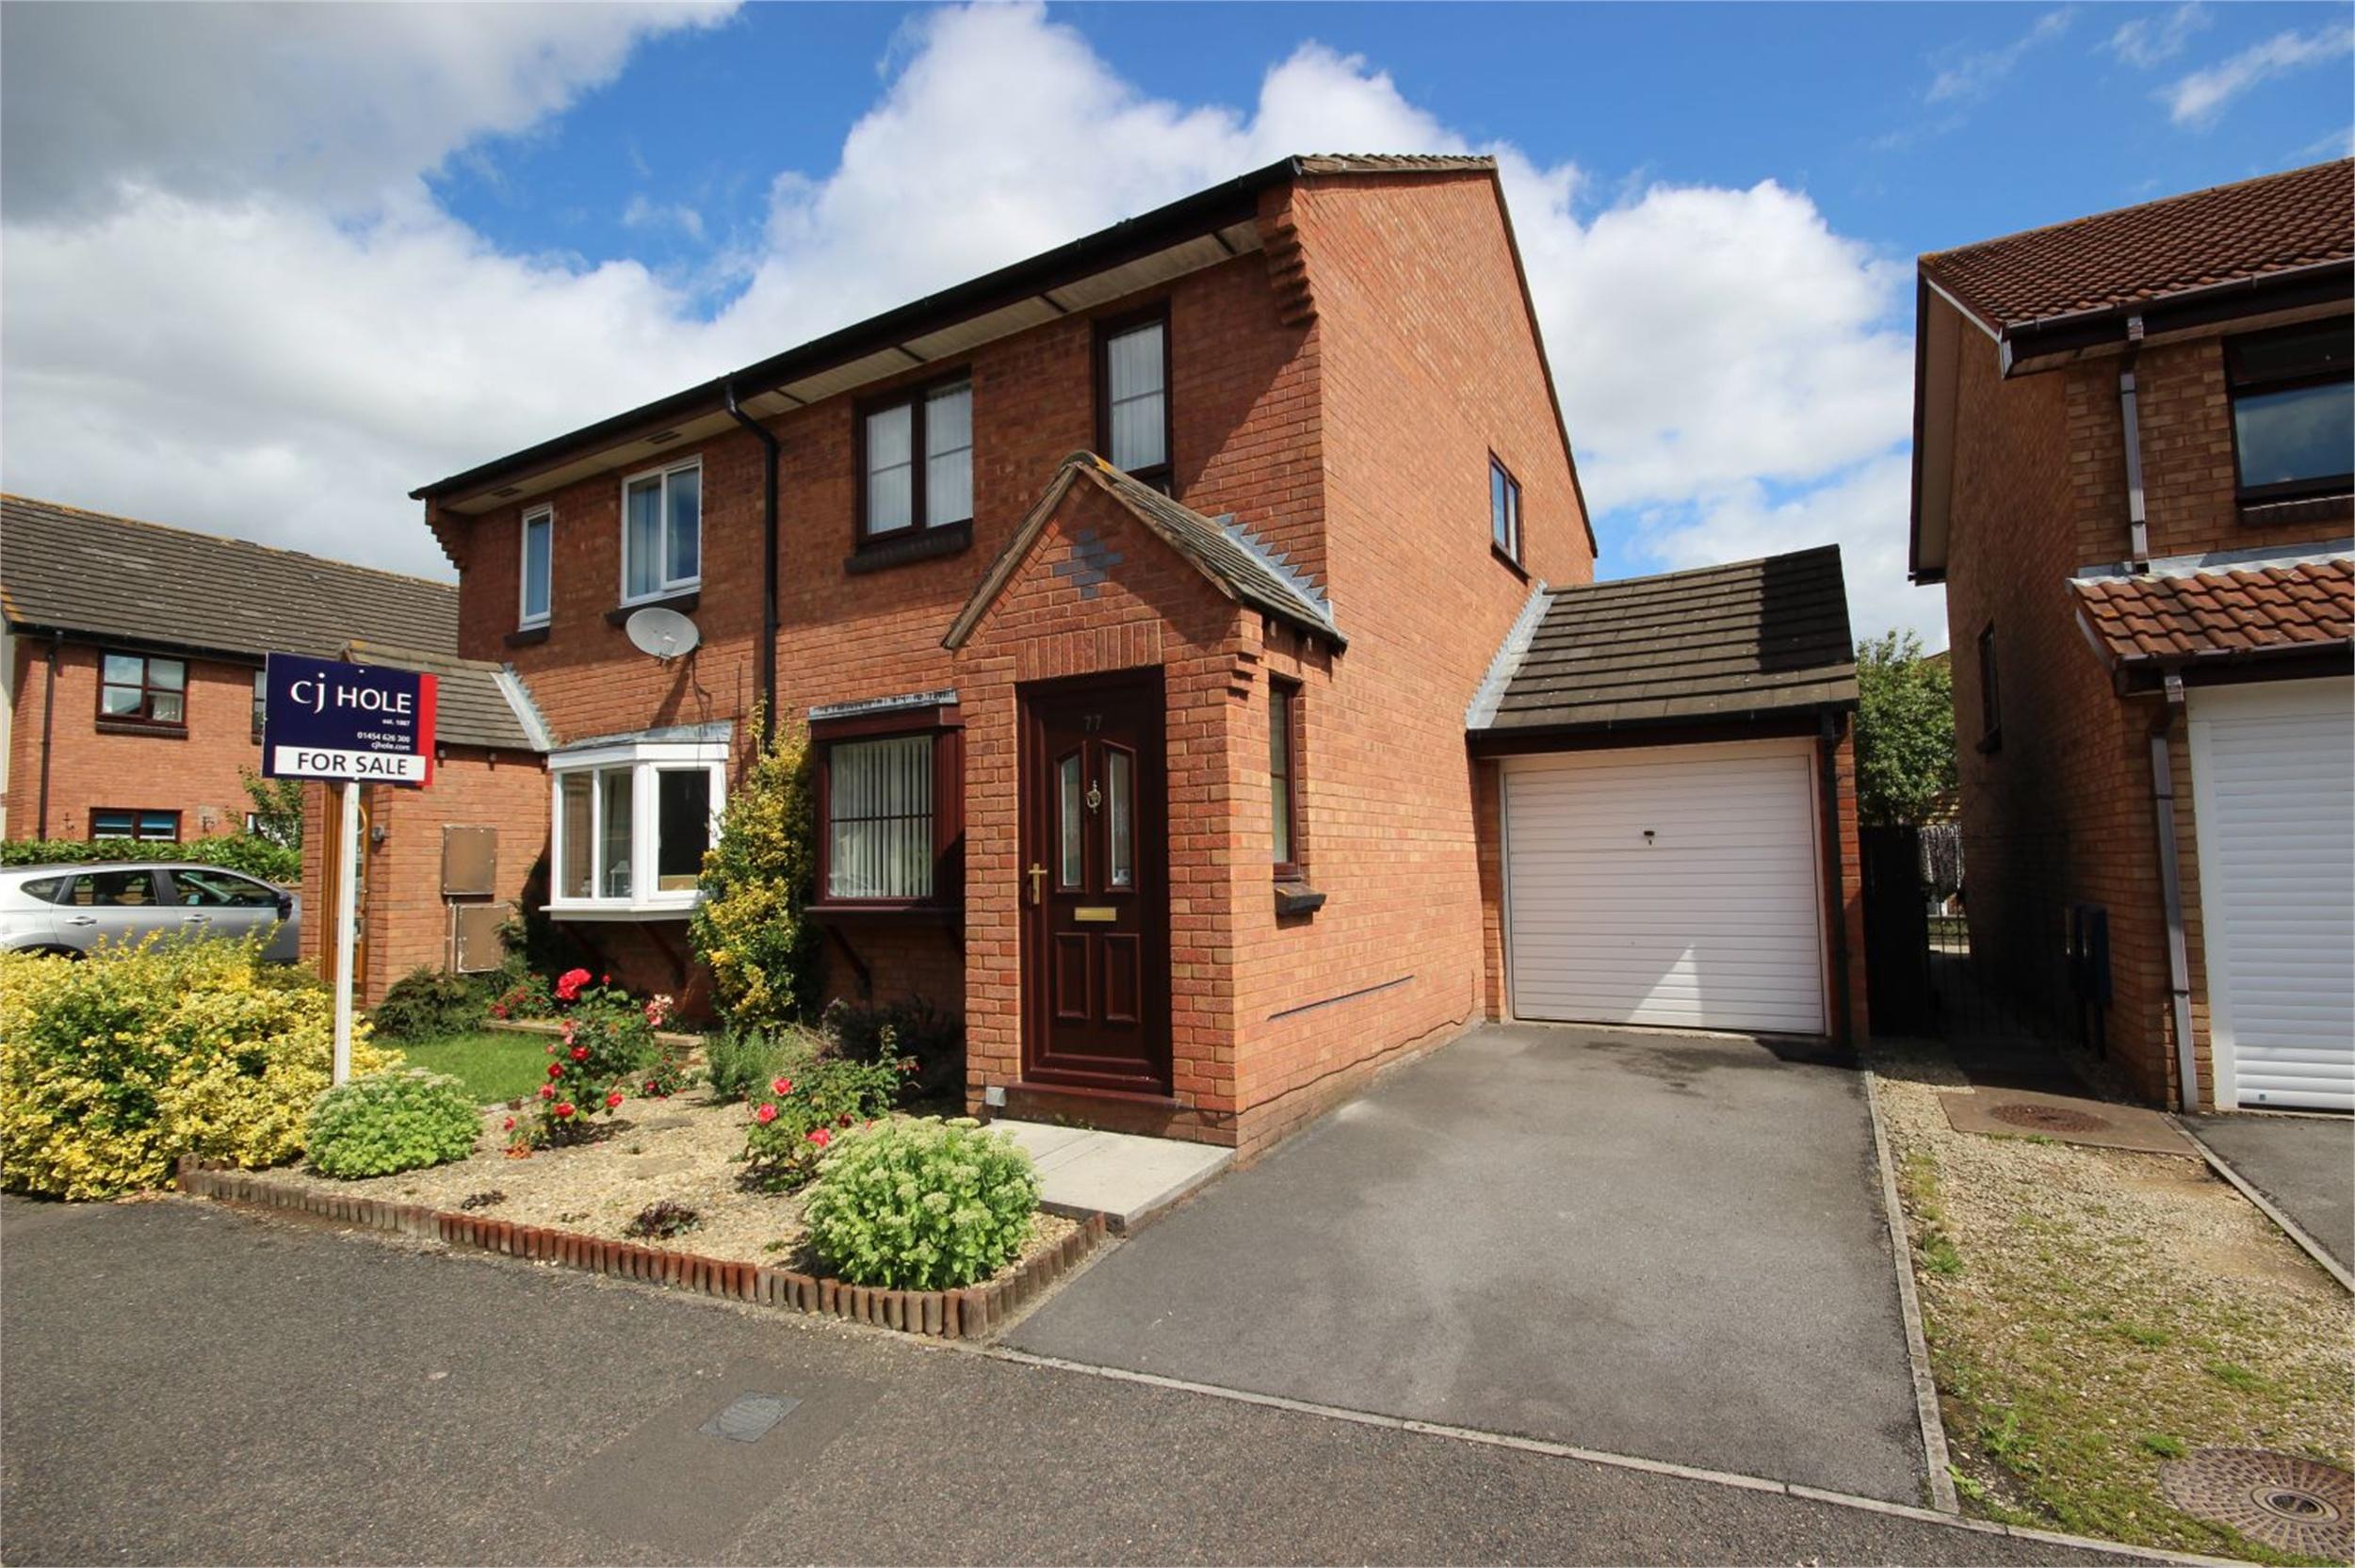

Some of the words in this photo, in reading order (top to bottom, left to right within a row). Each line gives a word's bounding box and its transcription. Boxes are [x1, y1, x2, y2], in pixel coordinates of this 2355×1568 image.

[337, 686, 412, 714] HOLE
[1083, 715, 1102, 732] 77
[357, 732, 382, 741] 01454
[382, 734, 396, 742] 626
[371, 741, 412, 751] cjhole.com
[298, 752, 348, 772] FOR
[356, 756, 408, 775] SALE
